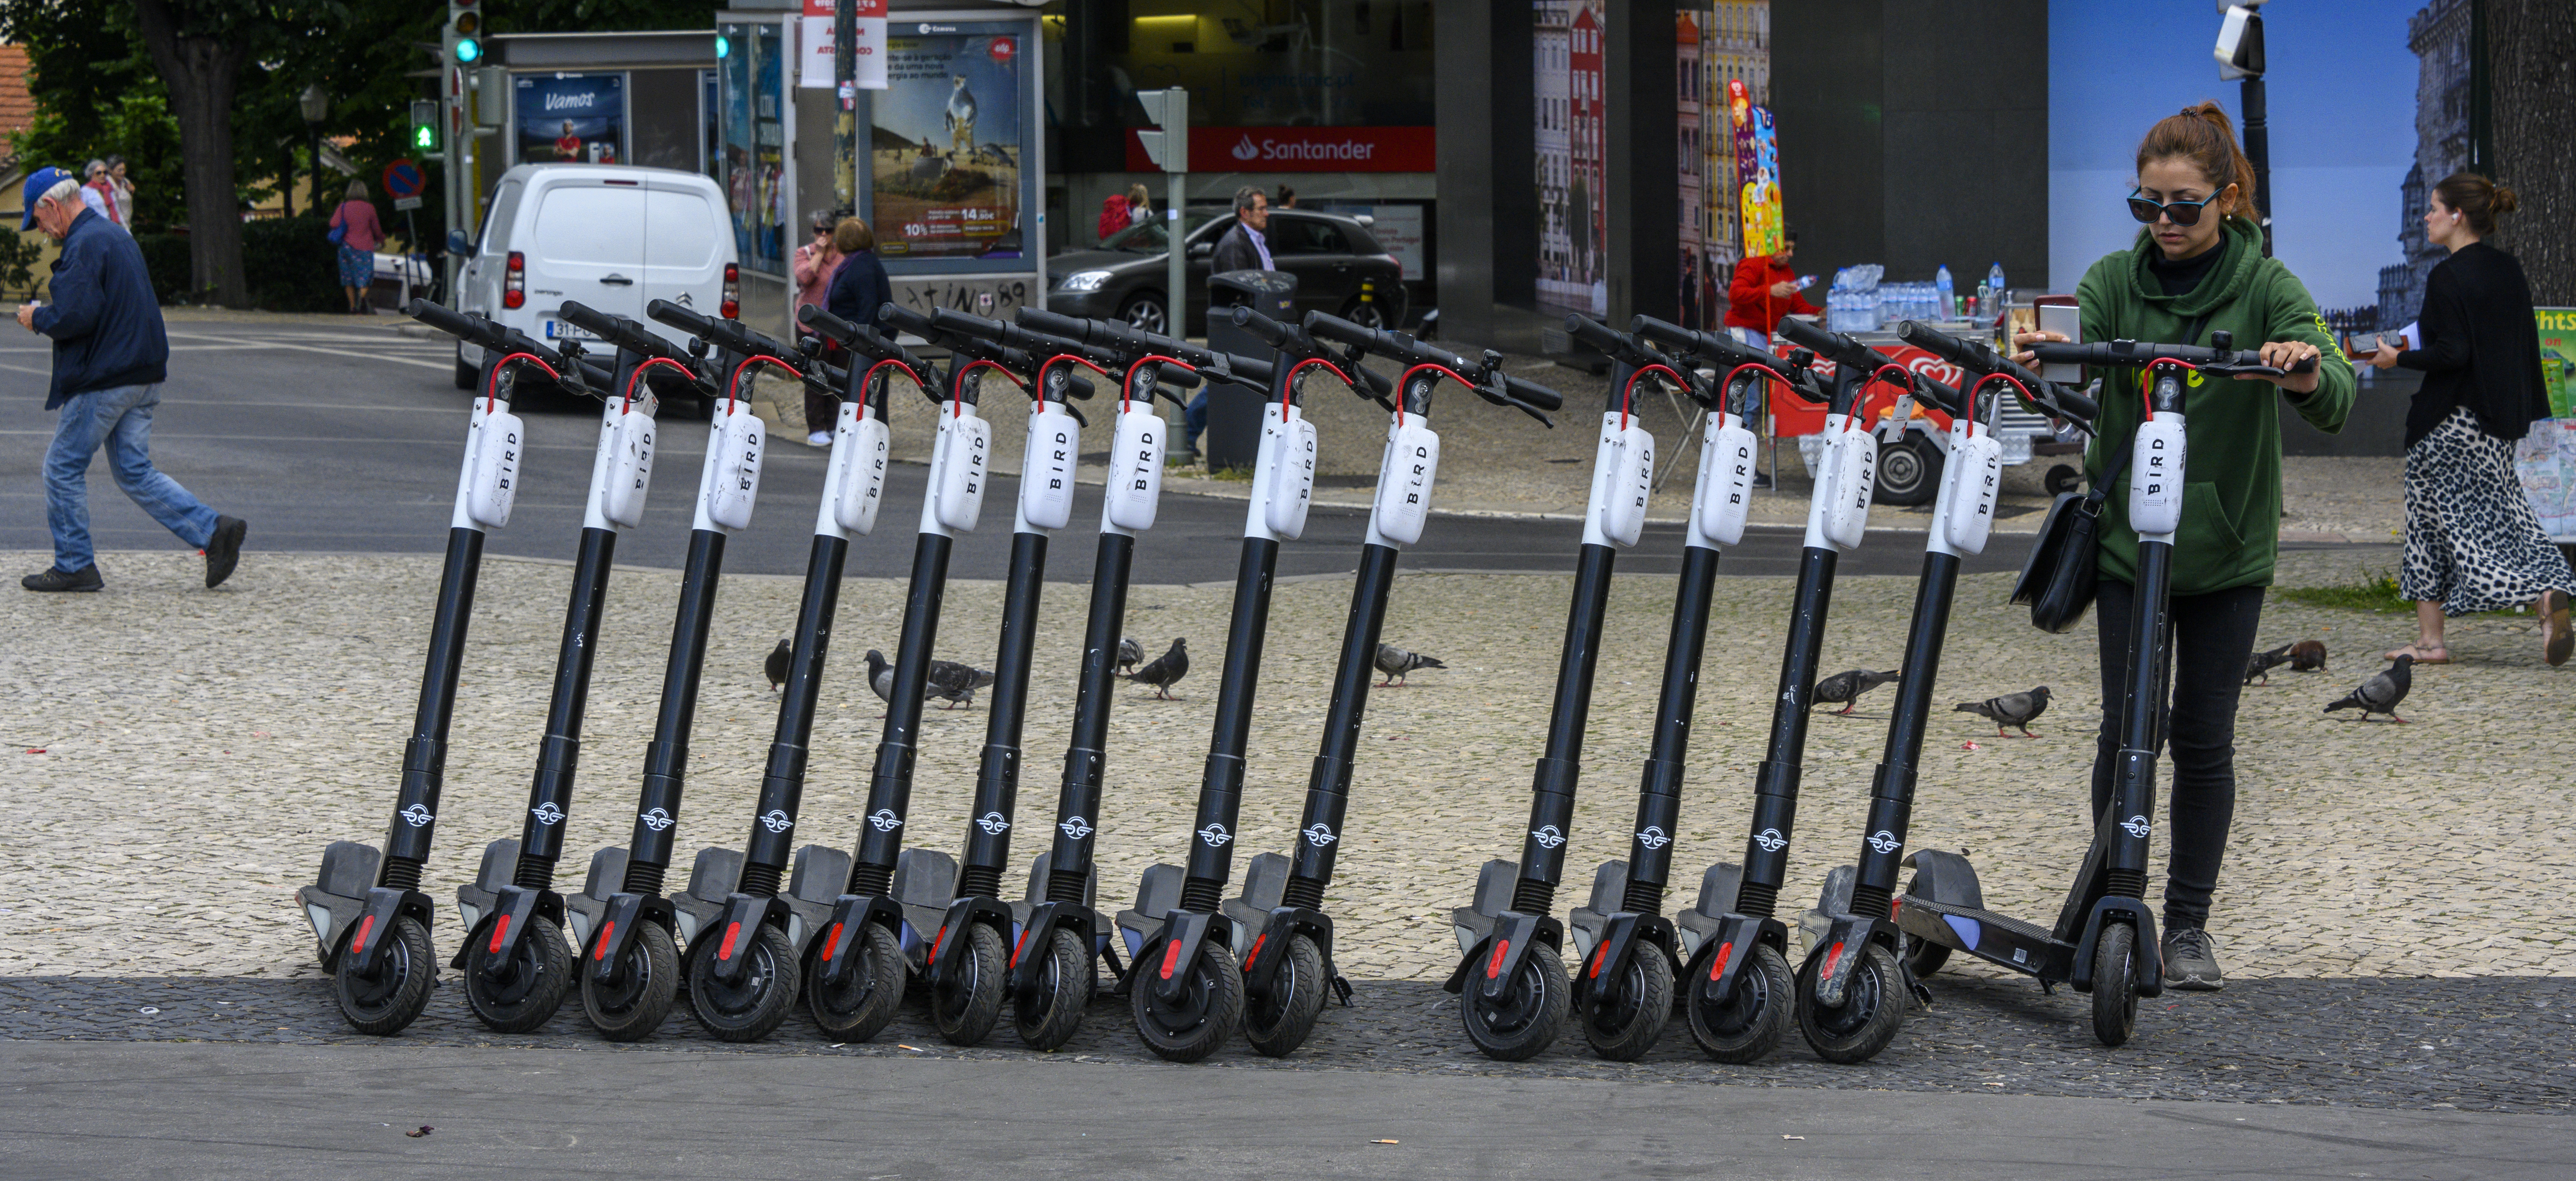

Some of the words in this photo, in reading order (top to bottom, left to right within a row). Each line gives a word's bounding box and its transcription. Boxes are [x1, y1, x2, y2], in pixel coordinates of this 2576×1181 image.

[995, 43, 1009, 54] edp
[545, 92, 594, 111] Vamos
[1263, 139, 1374, 160] Santander
[905, 223, 928, 236] 10%
[2545, 338, 2562, 346] on
[499, 433, 516, 490] BIRD
[740, 433, 757, 491] BIRD
[869, 441, 885, 498] BIRD
[967, 437, 984, 494] BIRD
[1050, 432, 1066, 489] BIRD
[1135, 432, 1153, 490] BIRD
[1300, 440, 1313, 499] BIRD
[1407, 446, 1427, 504] BIRD
[1636, 449, 1650, 508] BIRD
[1730, 447, 1748, 505] BIRD
[1856, 451, 1872, 509] BIRD
[1978, 457, 1996, 515] BIRD
[2148, 439, 2164, 495] BIRD
